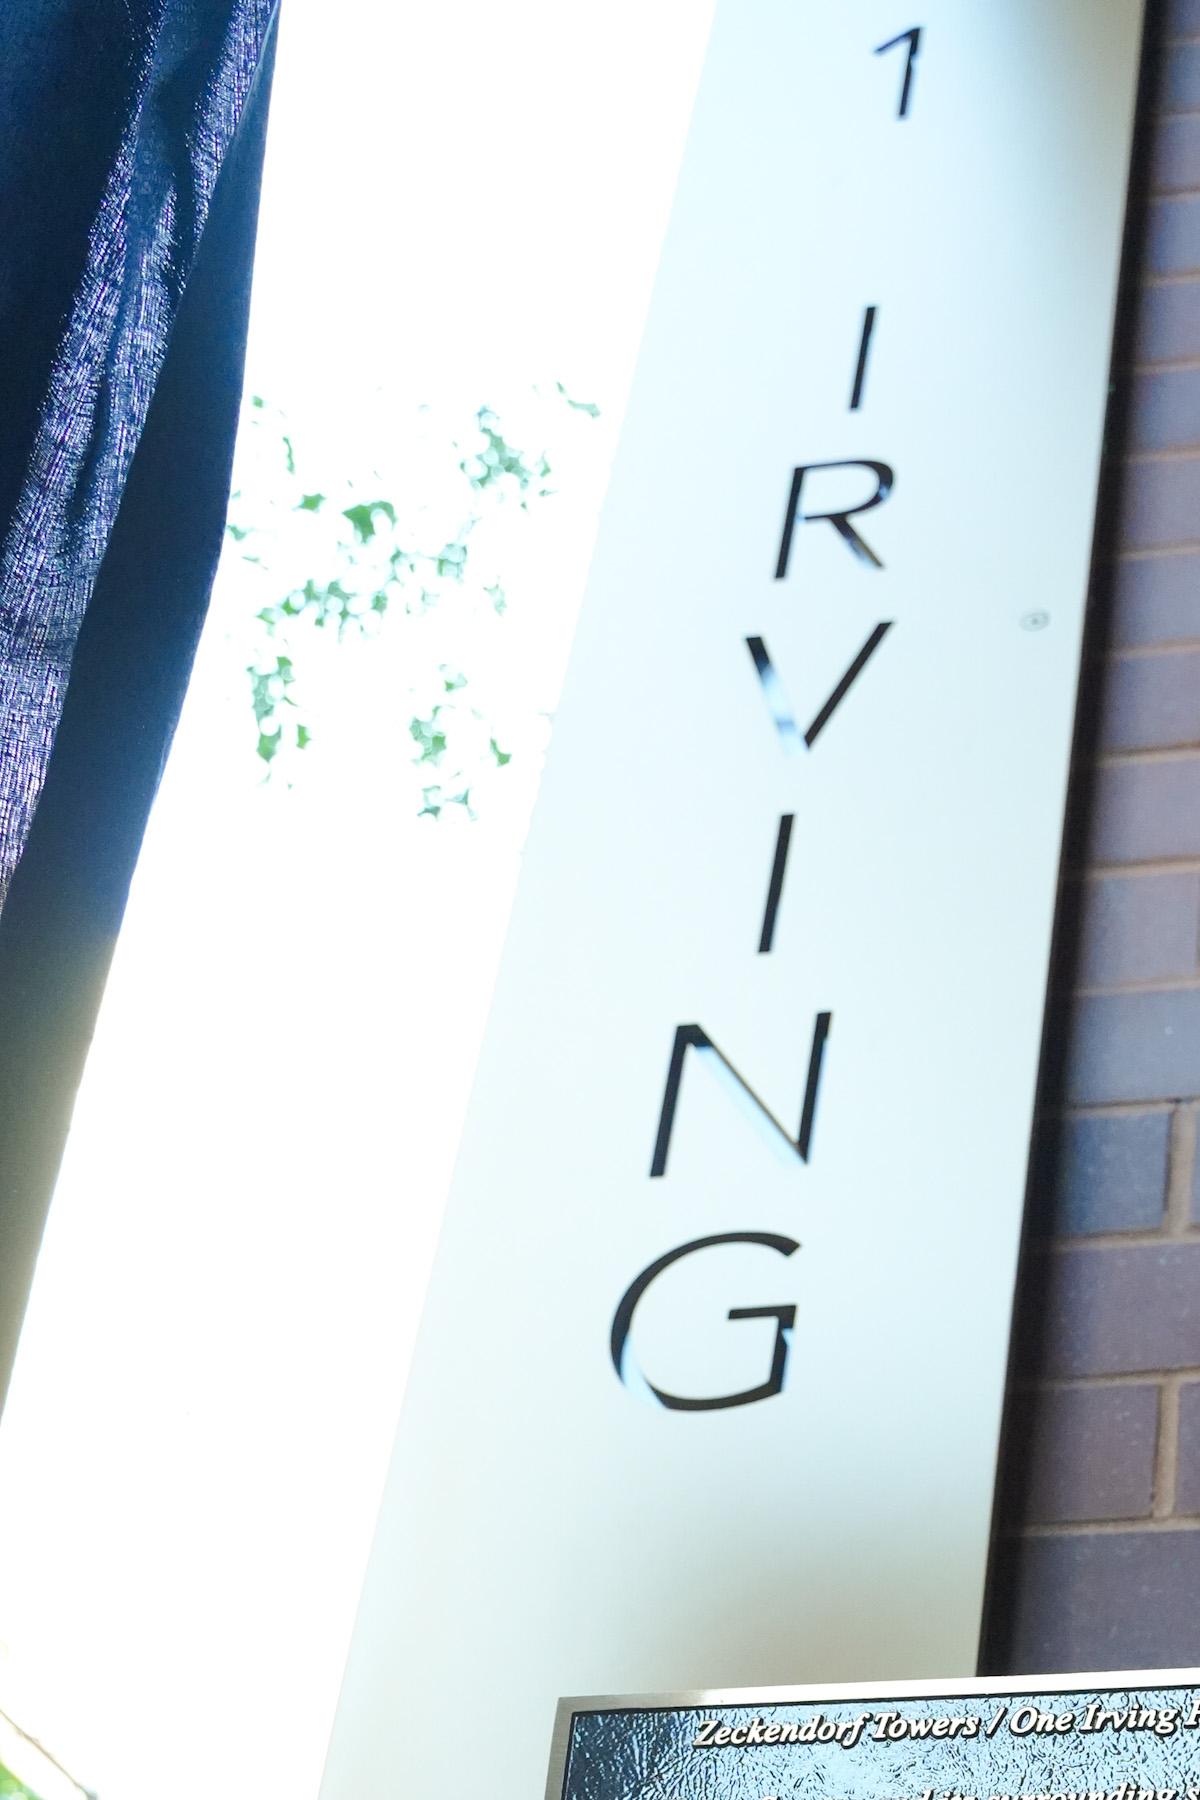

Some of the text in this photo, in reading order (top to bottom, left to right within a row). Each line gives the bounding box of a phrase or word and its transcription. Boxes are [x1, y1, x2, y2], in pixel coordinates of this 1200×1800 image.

[874, 25, 924, 120] 1
[609, 304, 896, 1413] IRVING
[693, 1713, 870, 1747] Zeckendorf
[871, 1711, 979, 1739] Towers
[985, 1707, 1003, 1737] /
[1010, 1706, 1071, 1735] One
[1081, 1703, 1178, 1735] Irving
